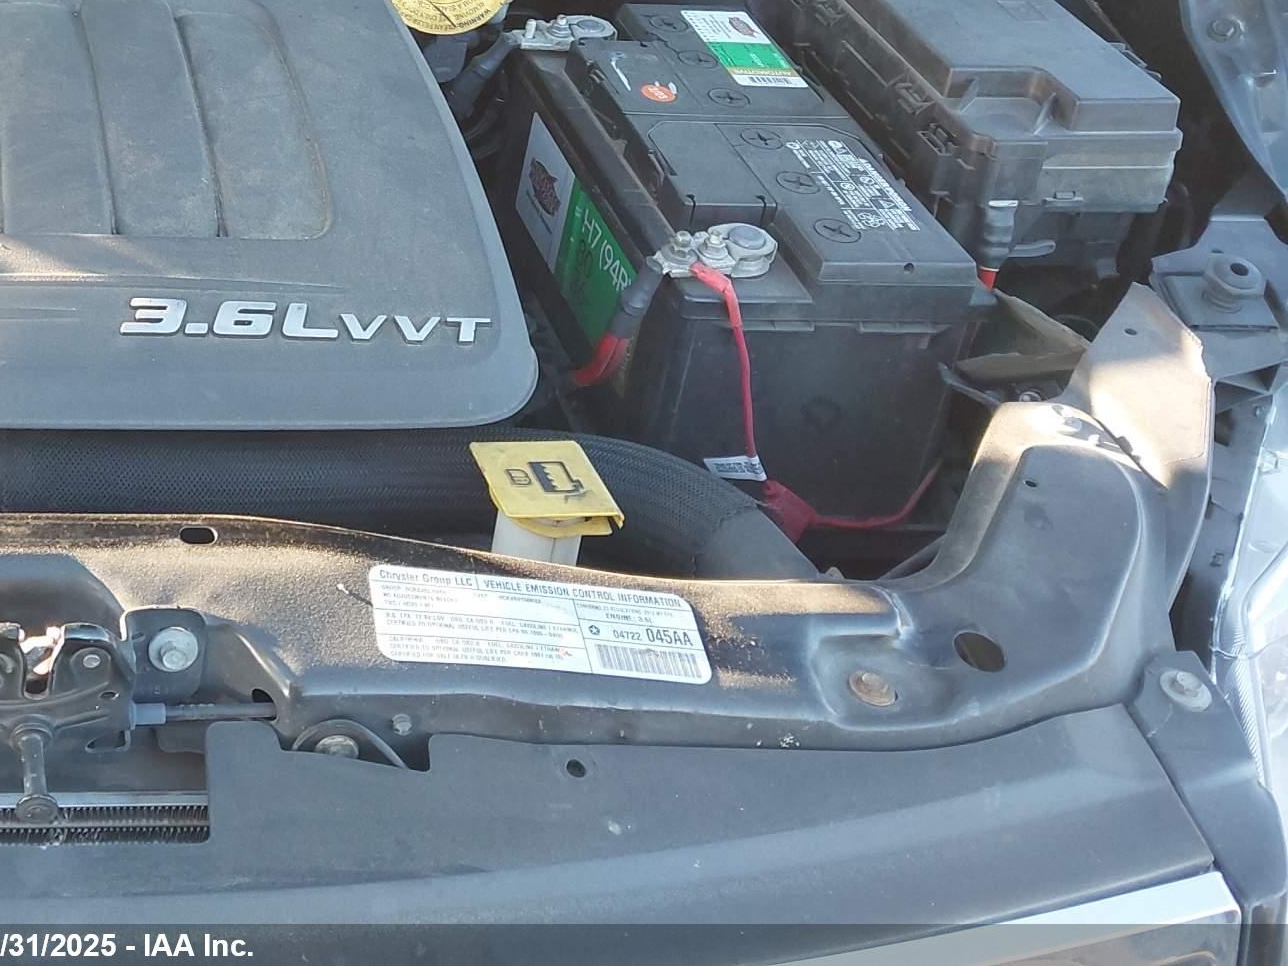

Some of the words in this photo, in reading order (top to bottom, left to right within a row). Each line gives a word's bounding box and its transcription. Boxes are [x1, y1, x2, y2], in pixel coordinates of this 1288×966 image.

[119, 296, 339, 338] 3.6L
[339, 313, 492, 345] VVT
[378, 568, 419, 582] Chrysler
[421, 573, 452, 585] Group
[453, 576, 473, 586] LLC
[482, 578, 523, 592] VEHICLE
[524, 583, 570, 596] EMISSION
[571, 587, 616, 601] CONTROL
[617, 592, 682, 607] INFORMATION
[611, 628, 642, 641] 04722
[644, 626, 694, 646] 045AA
